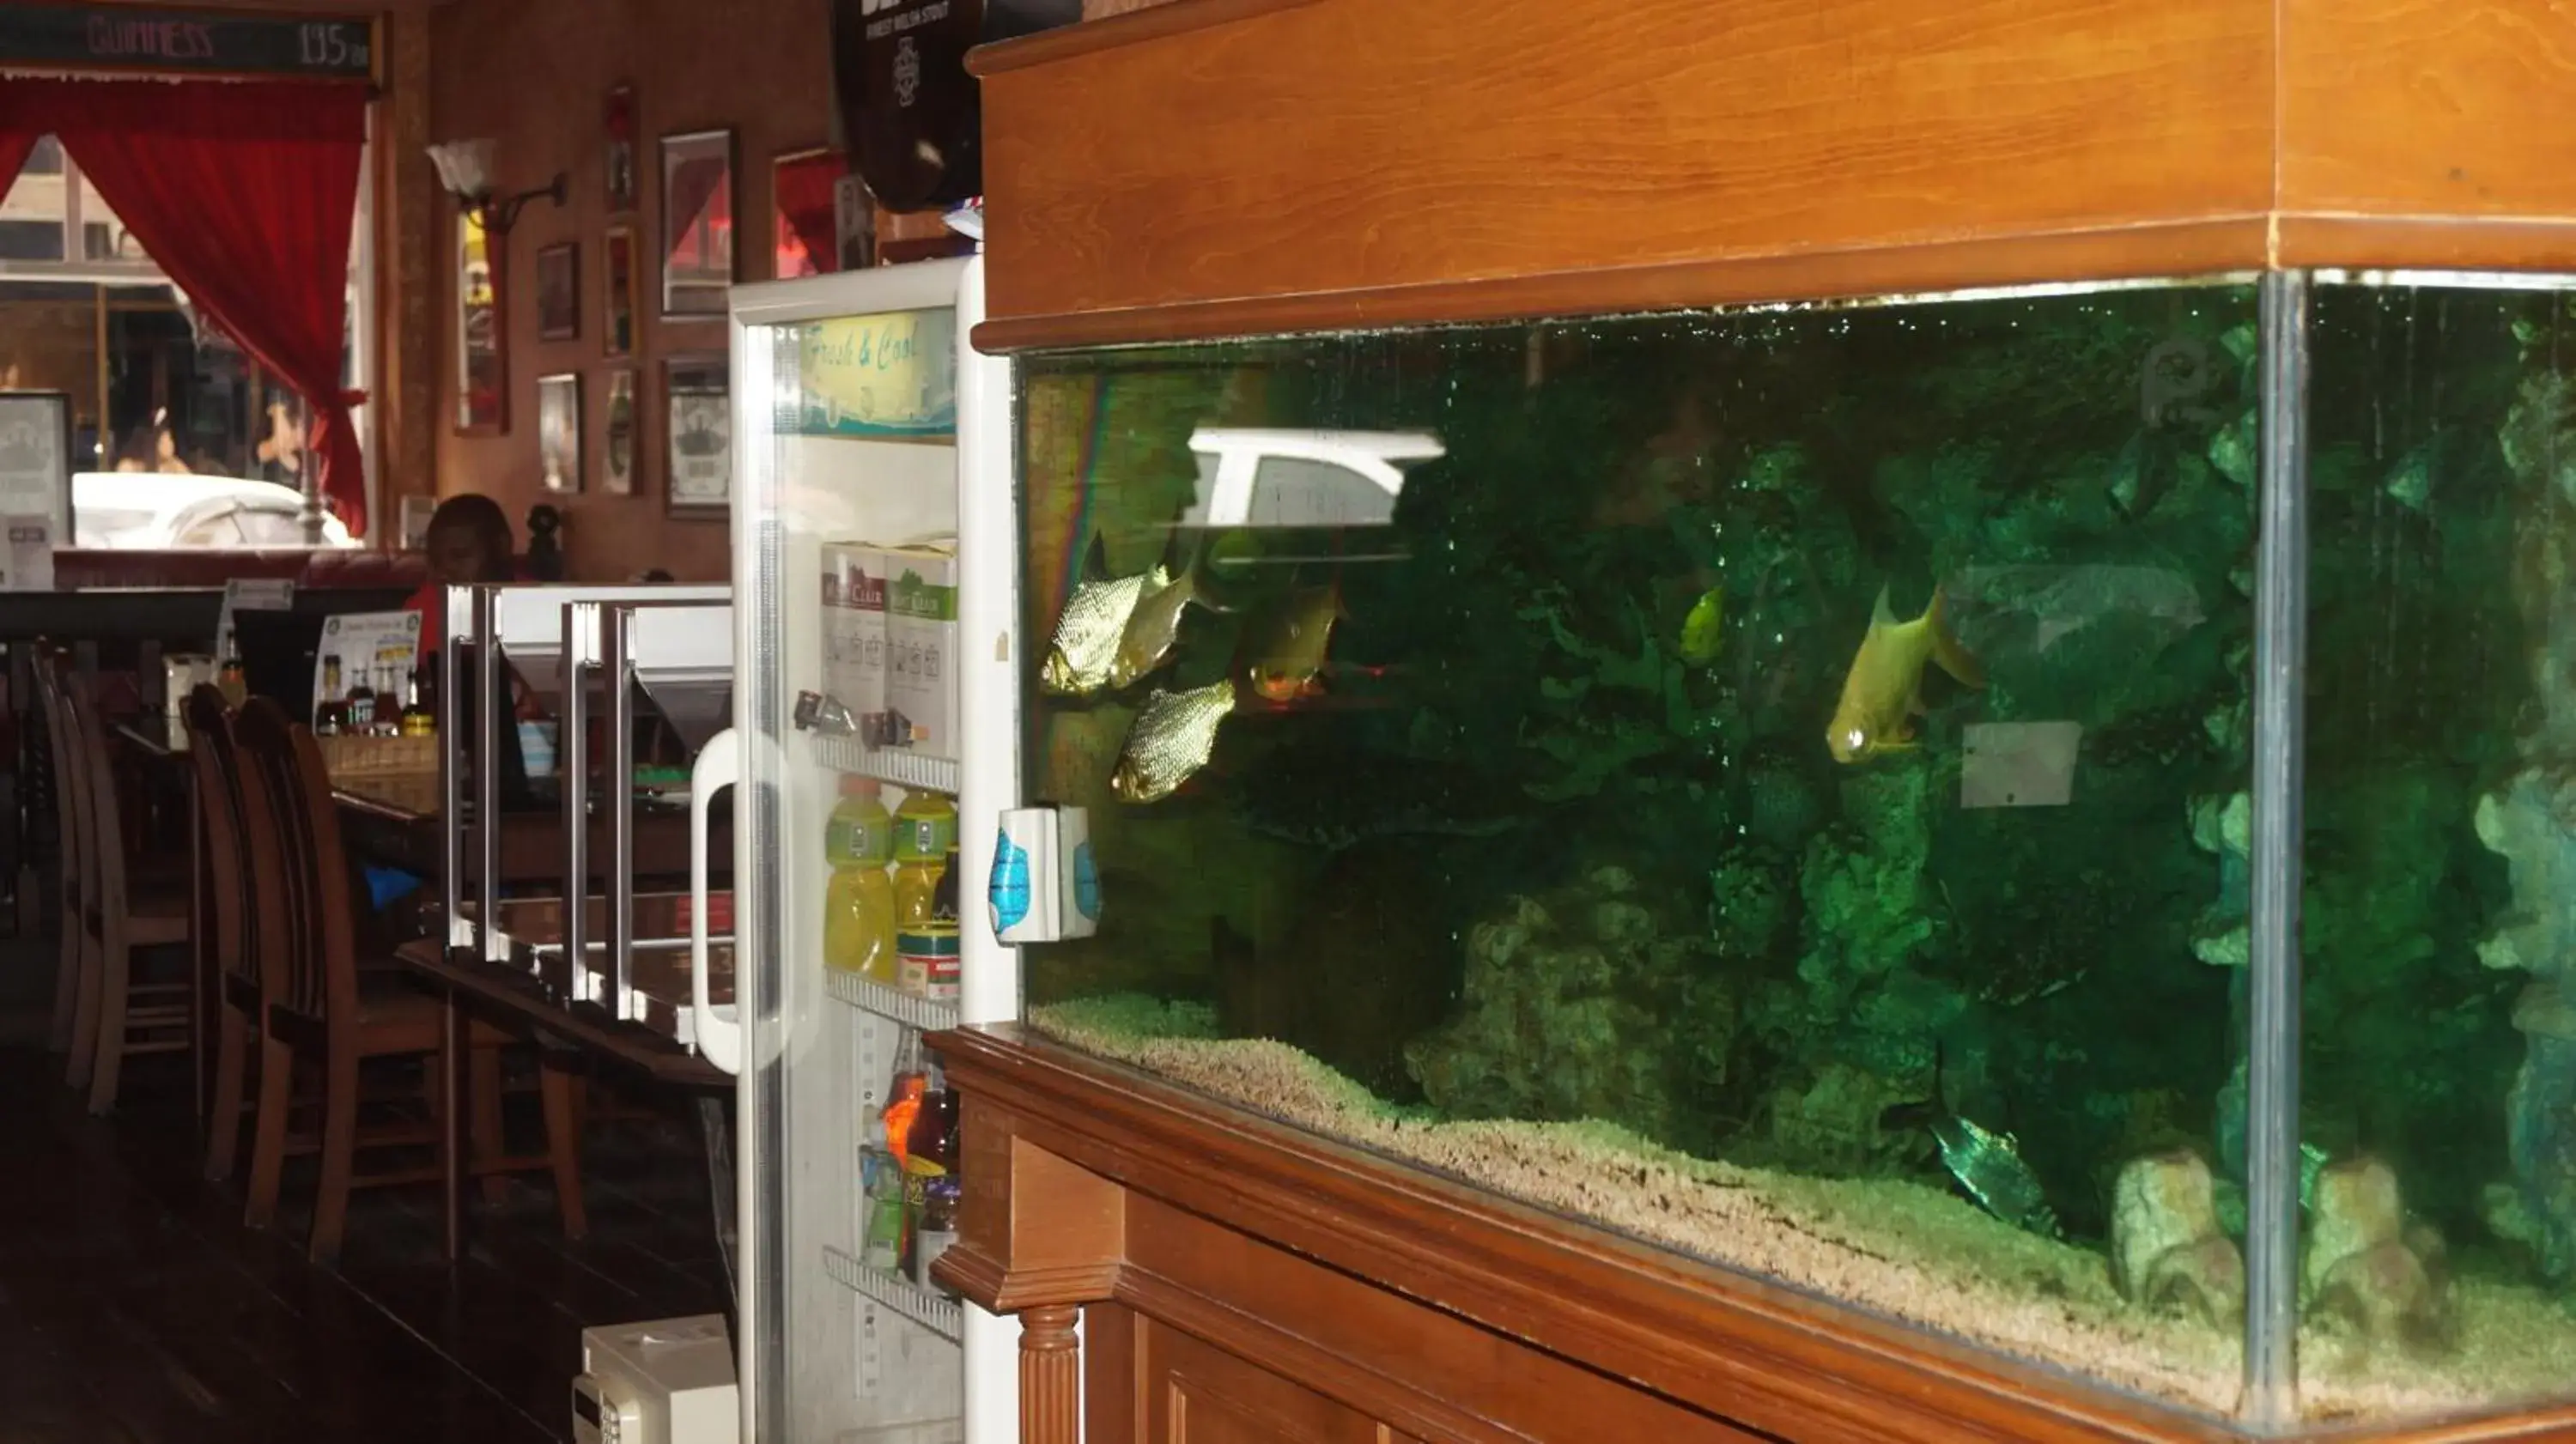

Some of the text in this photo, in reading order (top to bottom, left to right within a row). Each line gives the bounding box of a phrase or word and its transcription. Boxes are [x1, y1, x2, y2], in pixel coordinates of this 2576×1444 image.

[87, 15, 214, 57] GUINNESS
[808, 320, 919, 371] Fresh & Cool
